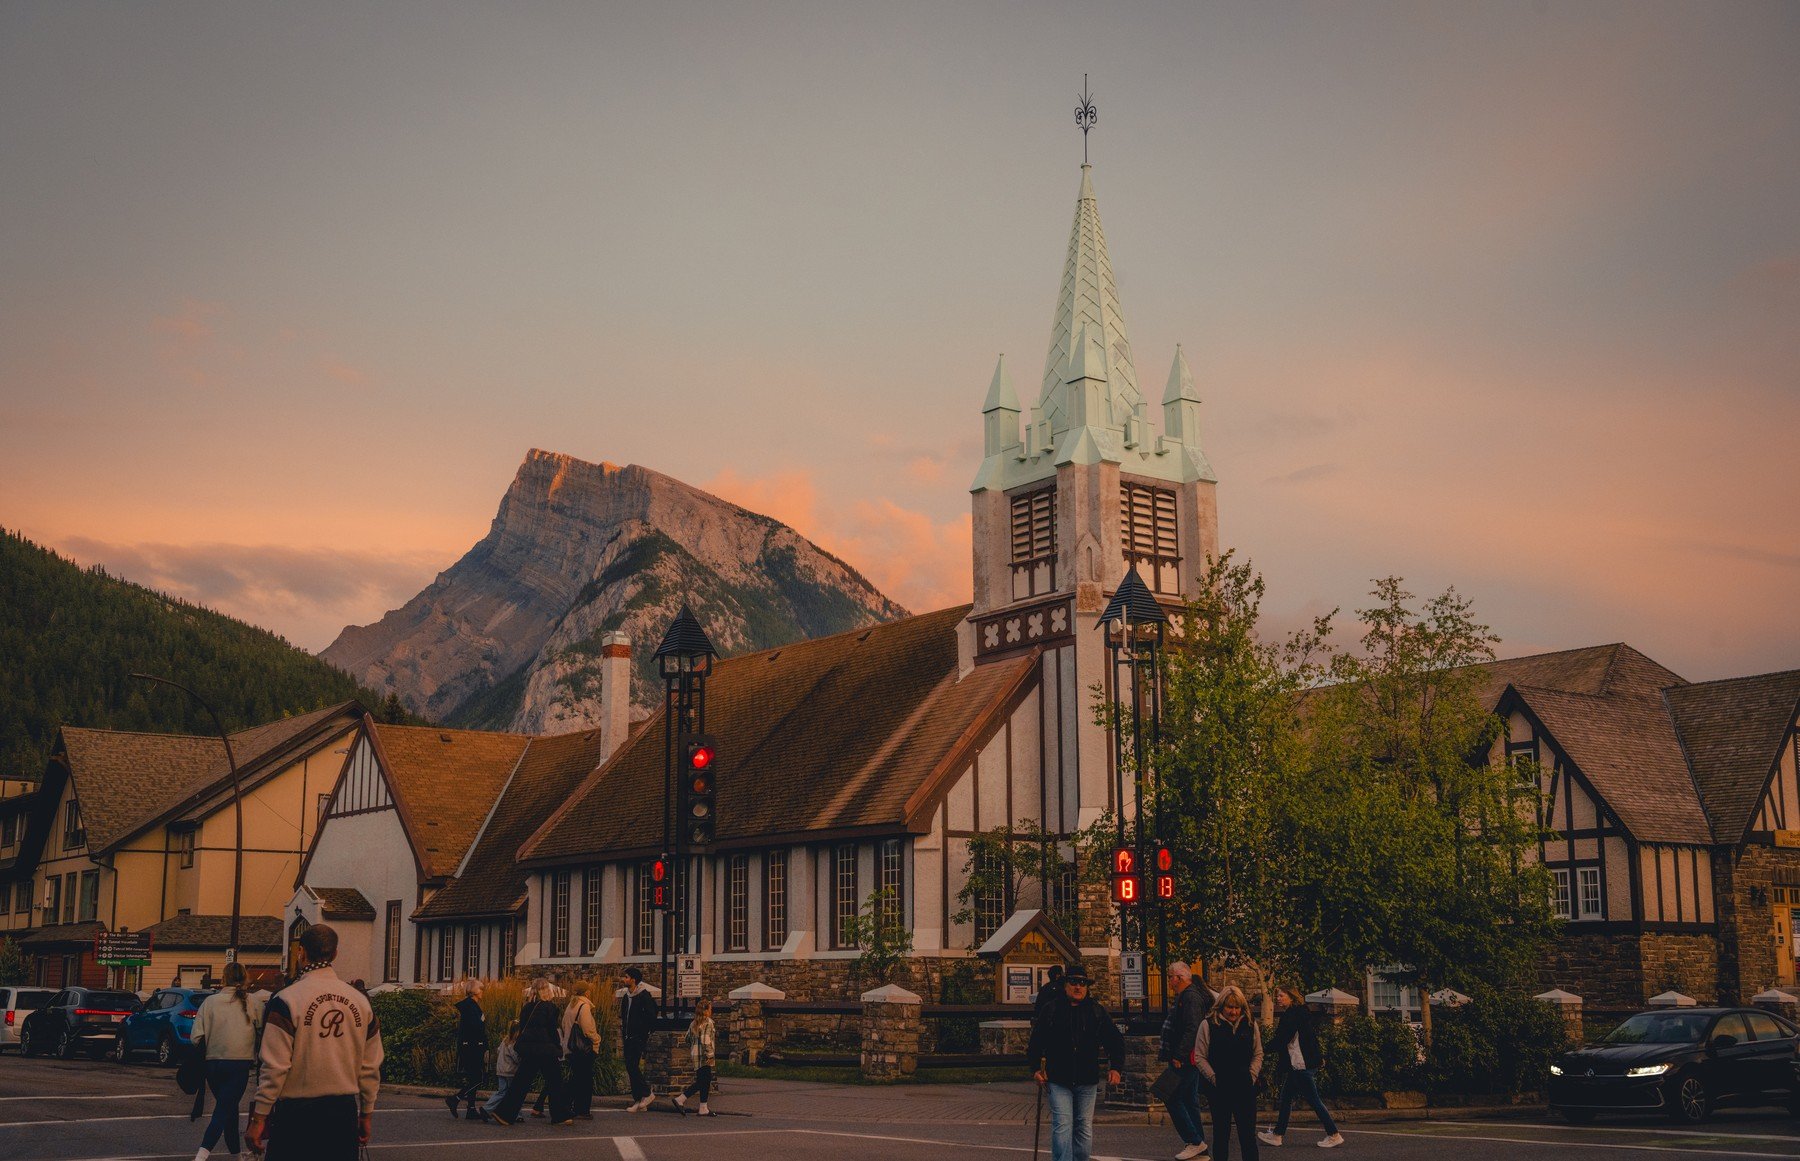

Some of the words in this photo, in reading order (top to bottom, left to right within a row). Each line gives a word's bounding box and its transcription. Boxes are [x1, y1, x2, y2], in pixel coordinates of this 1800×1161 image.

[1121, 879, 1133, 899] 13
[1161, 877, 1172, 897] 13
[304, 1002, 318, 1027] ROOTS
[315, 993, 349, 1005] SPORTING
[348, 1003, 362, 1028] GOODS
[319, 1009, 344, 1038] R
